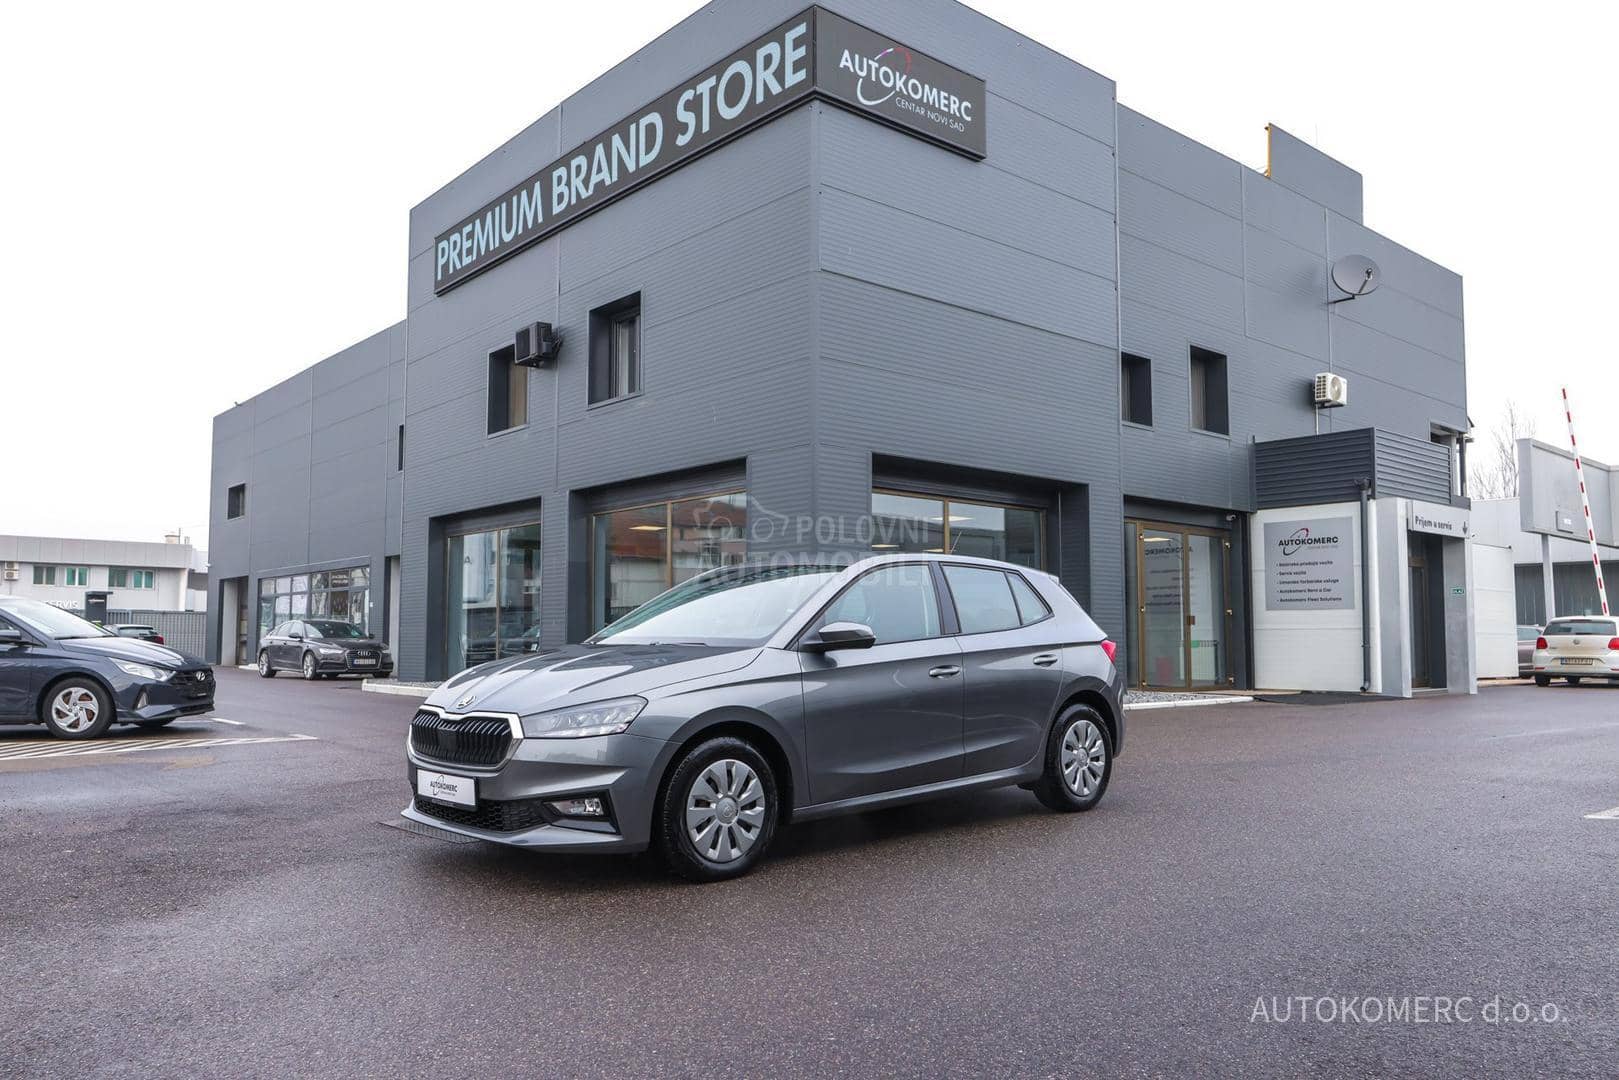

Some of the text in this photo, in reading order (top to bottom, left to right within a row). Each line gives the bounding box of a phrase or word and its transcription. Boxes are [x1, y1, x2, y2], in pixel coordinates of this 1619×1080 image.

[839, 48, 972, 122] AUTOKOMERC
[895, 96, 965, 132] CENTAR NOVI SAD
[436, 22, 807, 281] PREMIUM BRAND STORE
[1415, 515, 1433, 528] Prijem
[1438, 521, 1452, 530] servis
[1278, 536, 1339, 546] AUTOKOMERC
[430, 780, 458, 793] AUTOKOMERC
